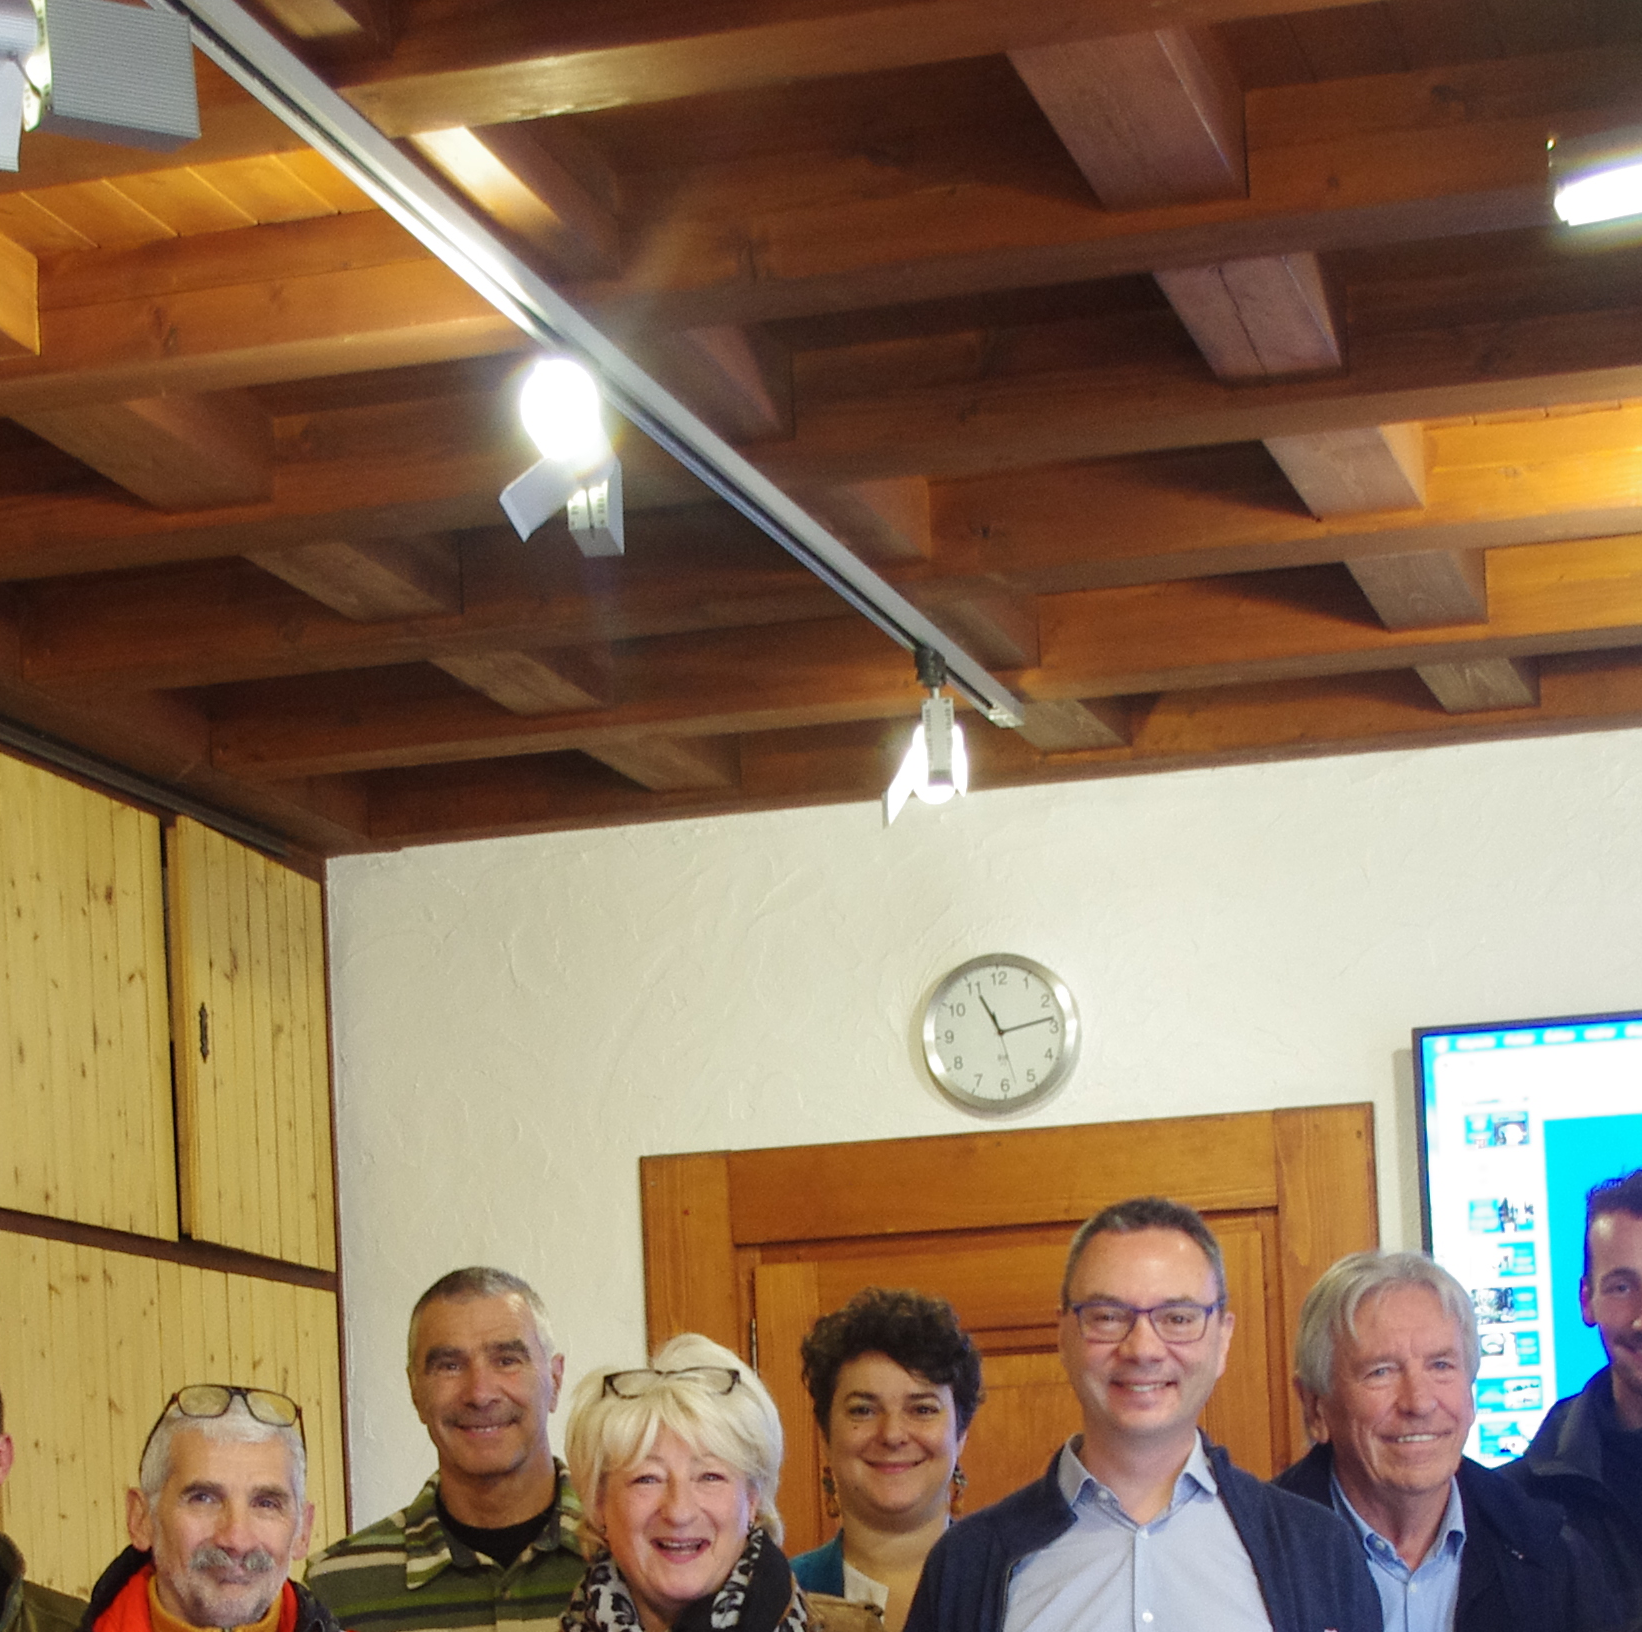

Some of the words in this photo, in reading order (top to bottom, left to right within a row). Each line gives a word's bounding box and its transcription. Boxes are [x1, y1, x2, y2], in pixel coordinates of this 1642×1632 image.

[991, 971, 1008, 986] 12
[1023, 977, 1030, 989] 1
[967, 982, 982, 995] 11
[1040, 994, 1050, 1008] 2
[949, 1003, 966, 1017] 10
[1049, 1020, 1059, 1034] 3
[944, 1030, 954, 1043] 9
[1044, 1048, 1054, 1061] 4
[954, 1056, 963, 1070] 8
[974, 1073, 983, 1087] 7
[1026, 1069, 1036, 1082] 5
[1000, 1079, 1010, 1092] 6
